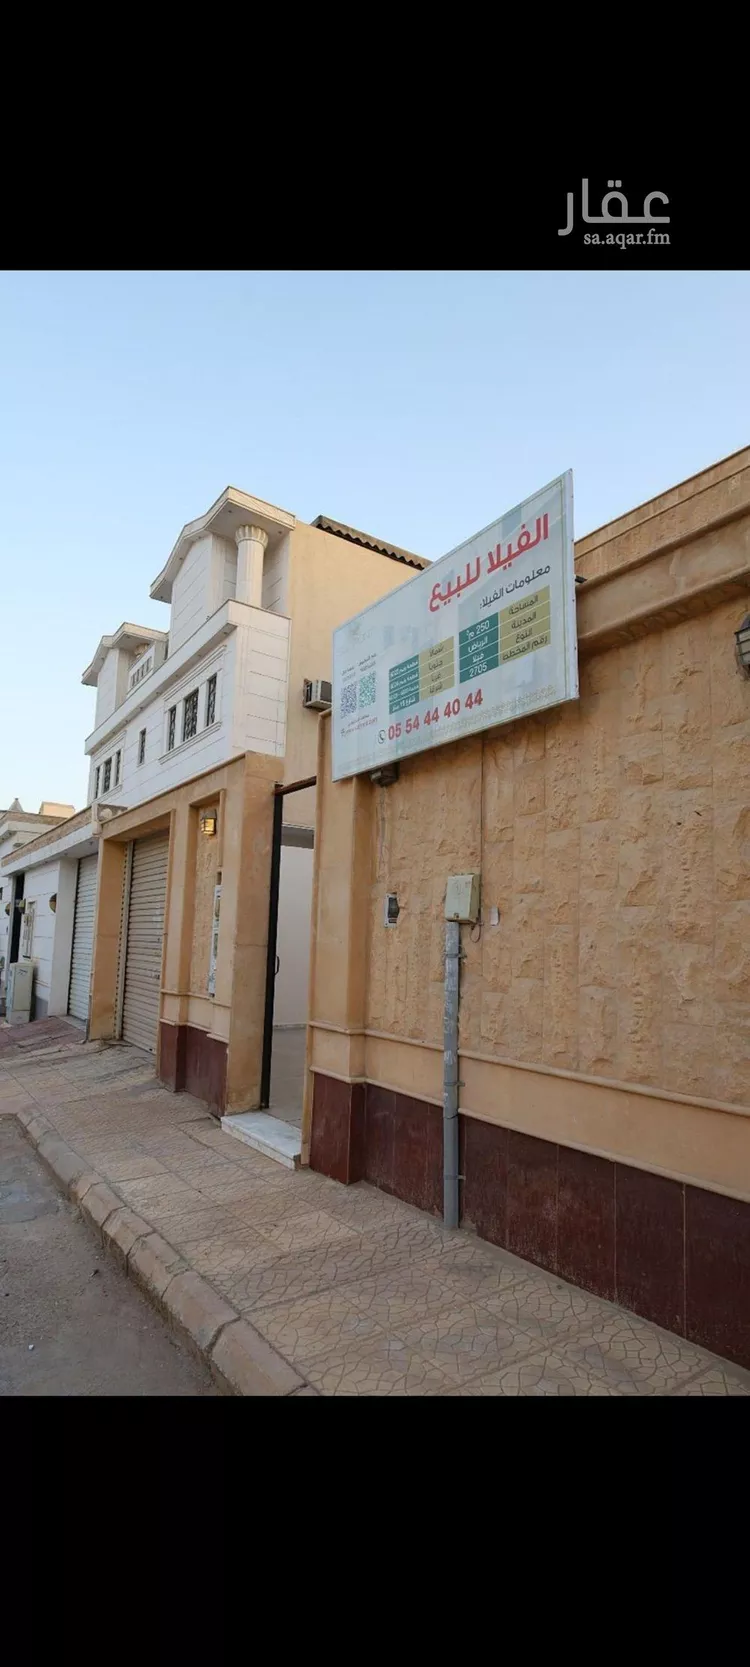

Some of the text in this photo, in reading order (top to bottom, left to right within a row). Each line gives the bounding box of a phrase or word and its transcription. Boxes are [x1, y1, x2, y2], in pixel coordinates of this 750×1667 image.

[429, 513, 549, 612] الفيلا للبيع
[505, 565, 551, 594] معلومات
[508, 594, 538, 615] المساحة
[475, 620, 490, 635] 250
[511, 611, 537, 629] المدينة
[467, 635, 488, 653] الرياض
[515, 627, 533, 644] النوع
[531, 635, 548, 650] رقم
[469, 662, 488, 677] 2705
[388, 723, 402, 740] 05
[405, 715, 420, 734] 54
[423, 707, 440, 726] 44
[443, 698, 461, 718] 40
[465, 688, 484, 710] 44
